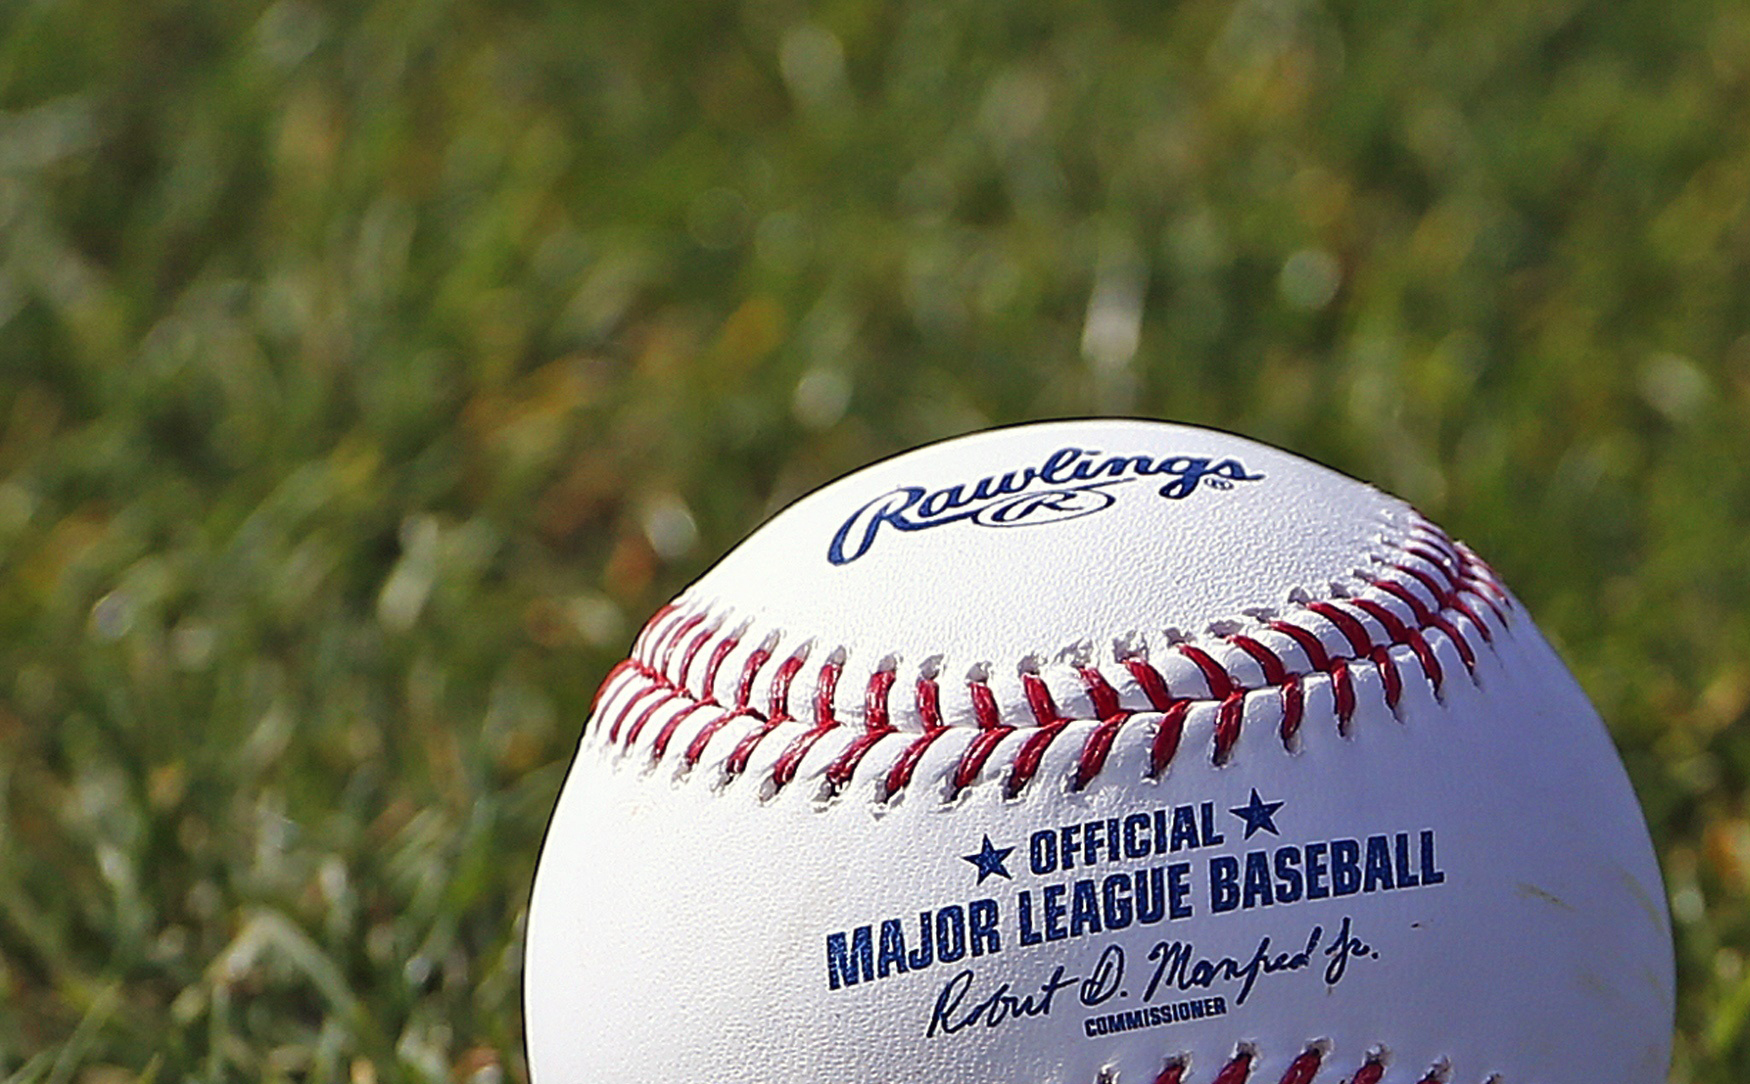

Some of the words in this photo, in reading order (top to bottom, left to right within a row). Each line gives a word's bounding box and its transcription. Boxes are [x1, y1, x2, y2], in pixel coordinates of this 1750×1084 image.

[828, 448, 1265, 566] Rawlings
[1029, 801, 1225, 876] OFFICIAL
[826, 899, 1001, 990] MAJOR
[1018, 859, 1193, 947] LEAGUE
[1210, 830, 1445, 914] BASEBALL
[1080, 945, 1127, 1007] D.
[1144, 926, 1320, 1004] Manfred
[1325, 917, 1379, 985] Jr.
[1084, 996, 1227, 1038] COMMISSIONER
